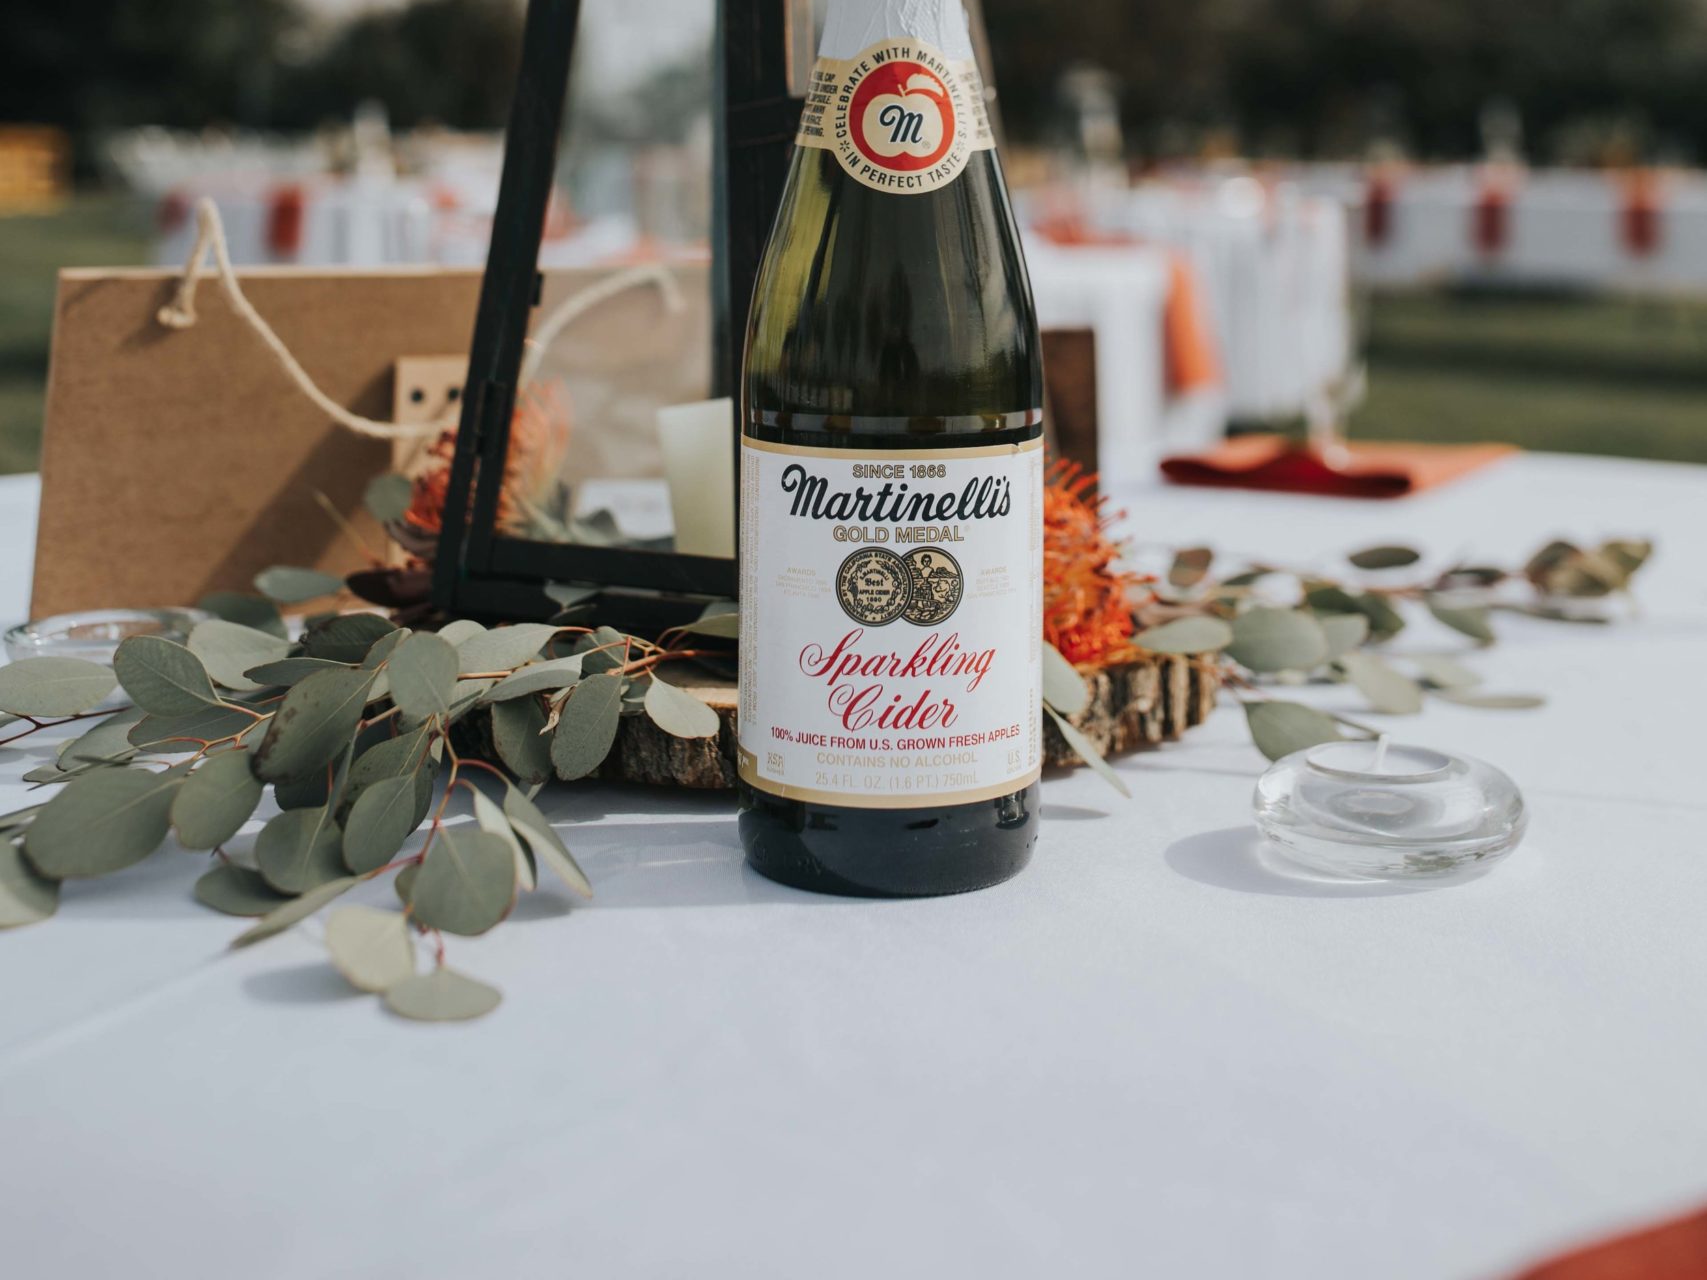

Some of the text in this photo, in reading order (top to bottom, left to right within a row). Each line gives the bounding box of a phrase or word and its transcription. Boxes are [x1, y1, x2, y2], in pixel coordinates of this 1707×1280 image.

[834, 61, 870, 138] CELEBRATE
[872, 47, 910, 61] WITH
[845, 151, 961, 188] IN PERFECT TASTE
[852, 463, 947, 479] SINCE 1868
[781, 463, 1011, 522] Martinelli's
[833, 525, 964, 543] GOLD MEDAL
[786, 567, 816, 577] AWARDS
[864, 577, 884, 586] Best
[799, 628, 996, 692] Sparkling
[828, 683, 958, 732] Cider
[771, 724, 1020, 751] 100% JUICE FROM U.S. GROWN FRESH APPLES
[816, 751, 978, 768] CONTAINS NO ALCOHOL
[815, 771, 838, 785] 25.4
[943, 770, 978, 786] 750mL
